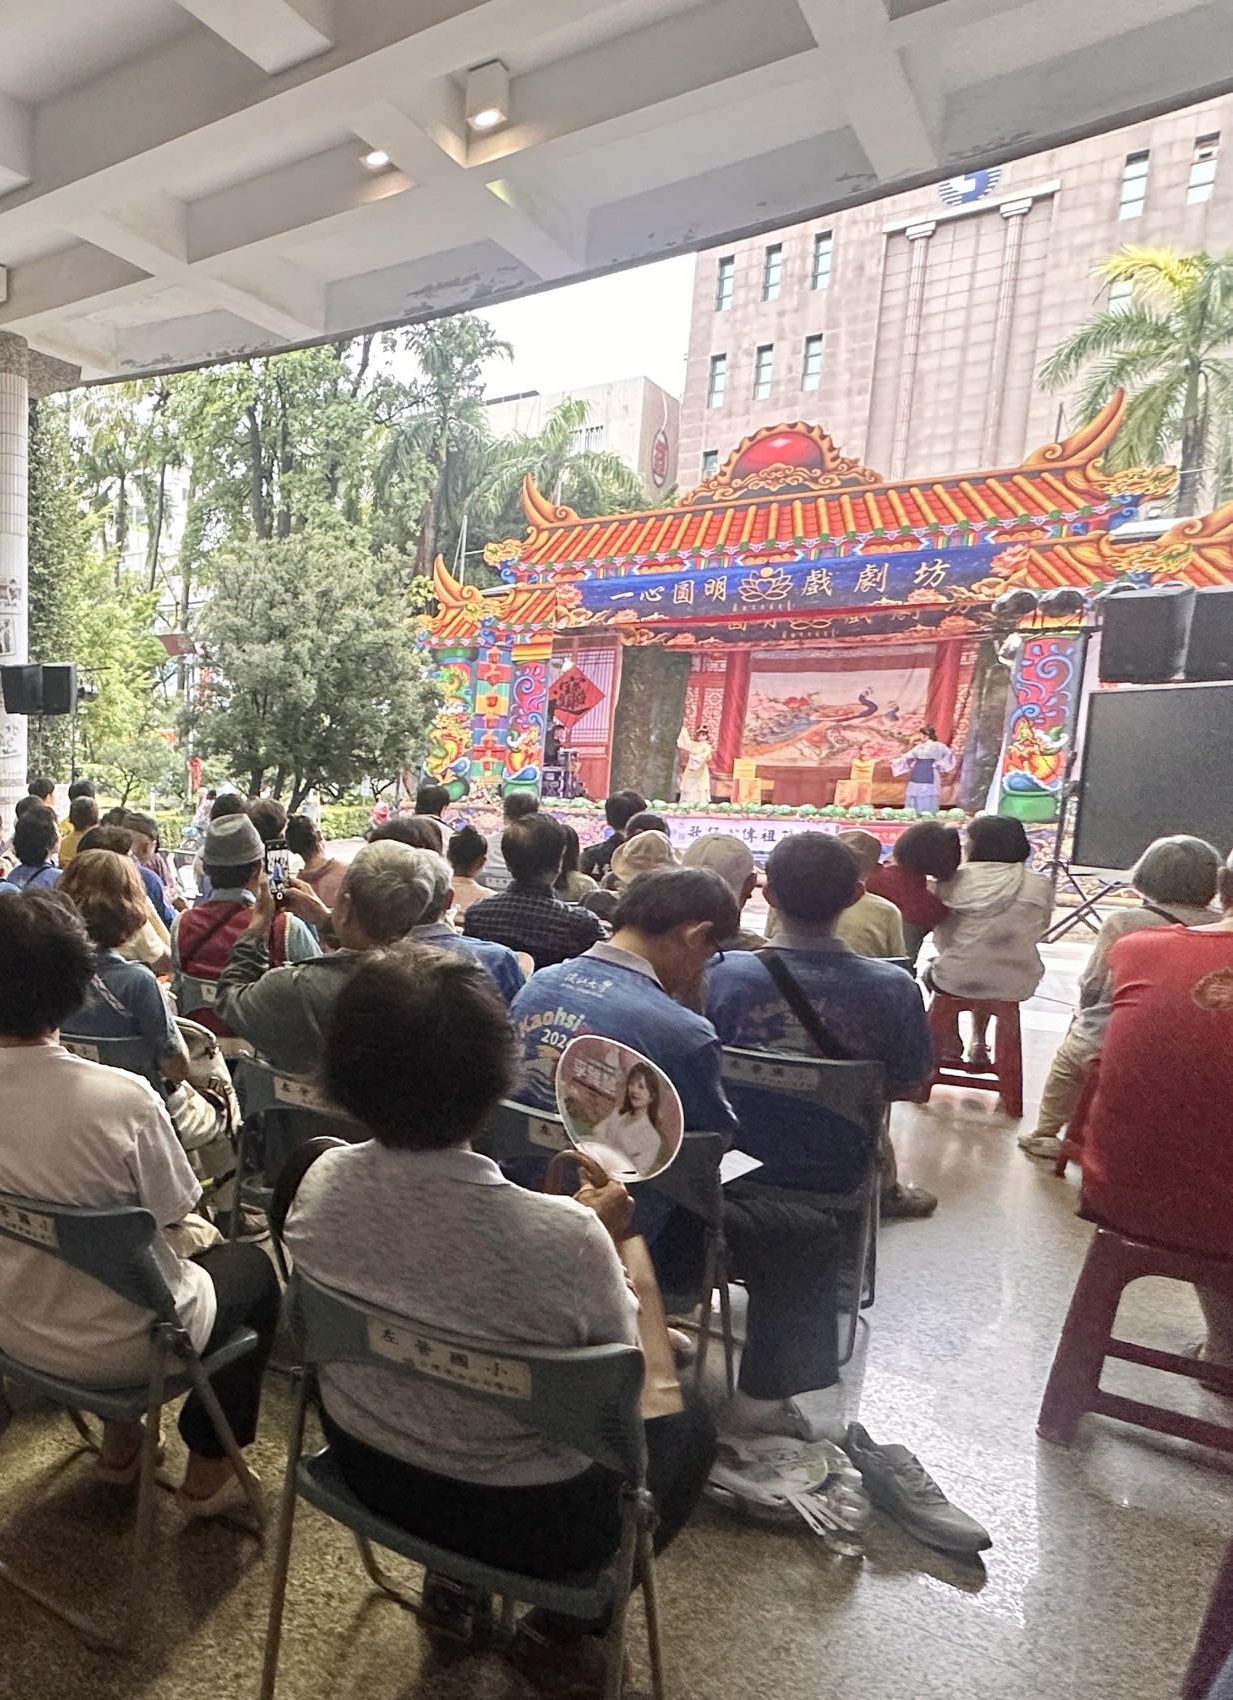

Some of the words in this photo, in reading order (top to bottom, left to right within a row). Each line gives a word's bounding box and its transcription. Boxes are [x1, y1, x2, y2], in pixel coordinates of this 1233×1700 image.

[610, 575, 727, 605] 一心圓明
[801, 558, 951, 597] 戲劇坊
